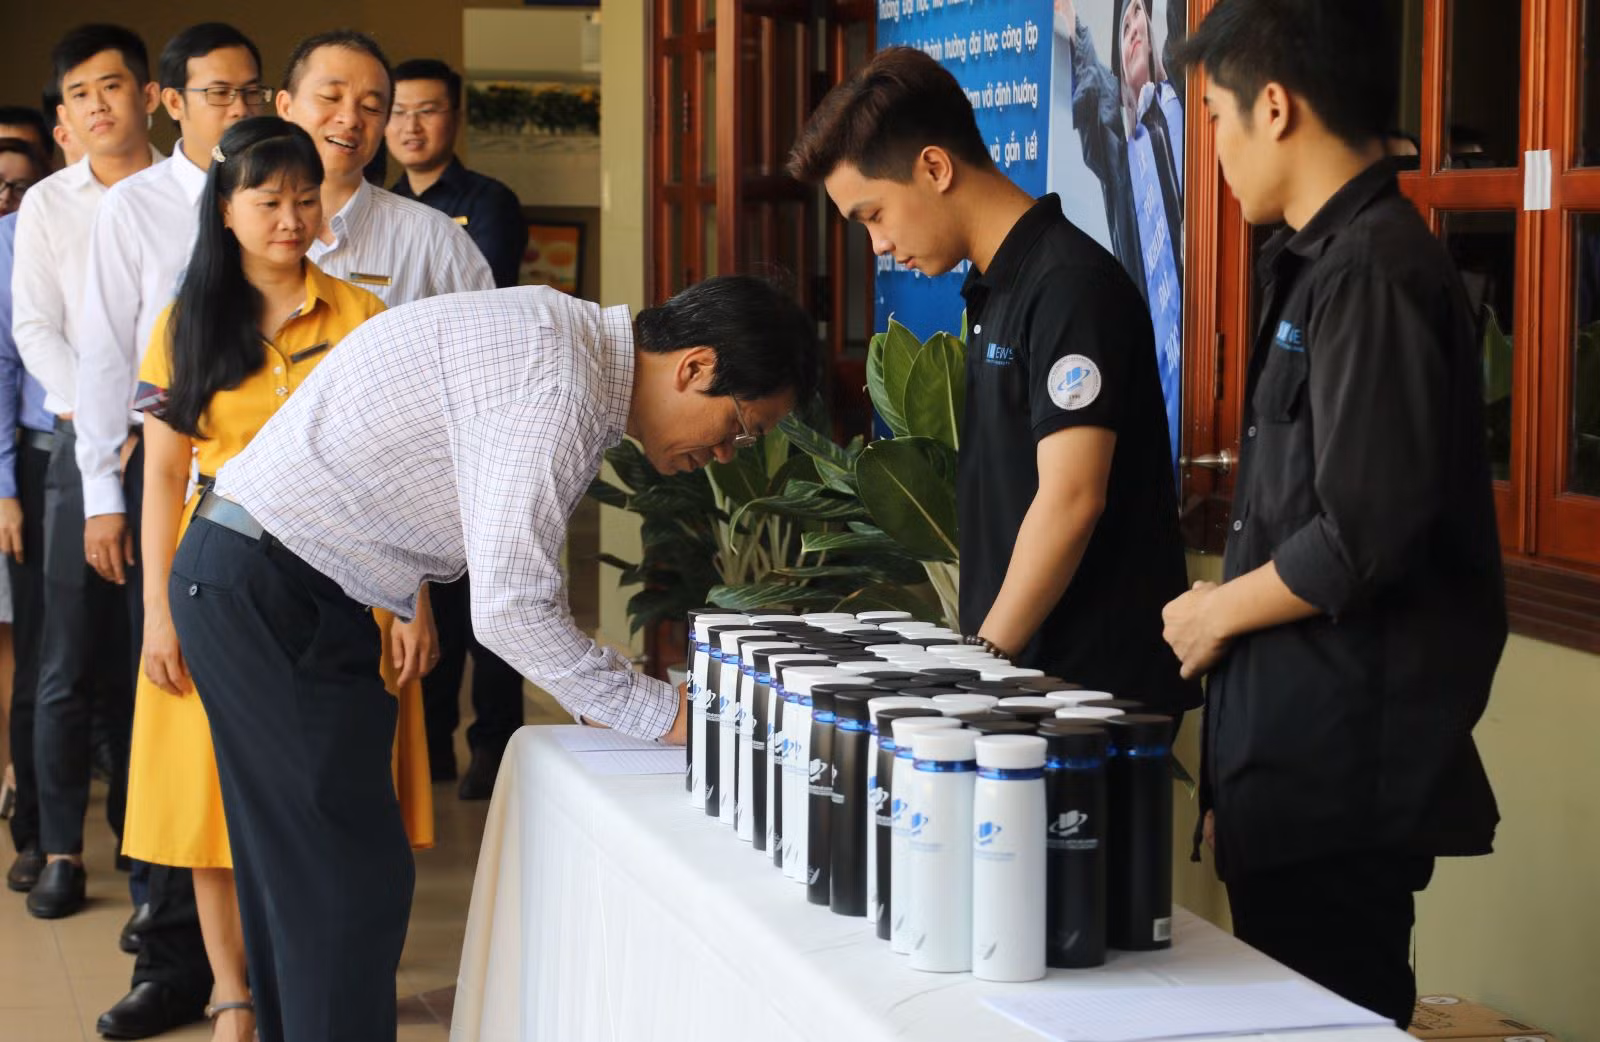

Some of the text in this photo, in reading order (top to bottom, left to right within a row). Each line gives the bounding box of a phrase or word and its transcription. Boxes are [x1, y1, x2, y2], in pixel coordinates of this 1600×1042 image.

[969, 29, 982, 60] đại
[983, 29, 999, 57] học
[1001, 24, 1022, 54] công
[1025, 20, 1039, 51] lập
[1012, 76, 1038, 109] hướng
